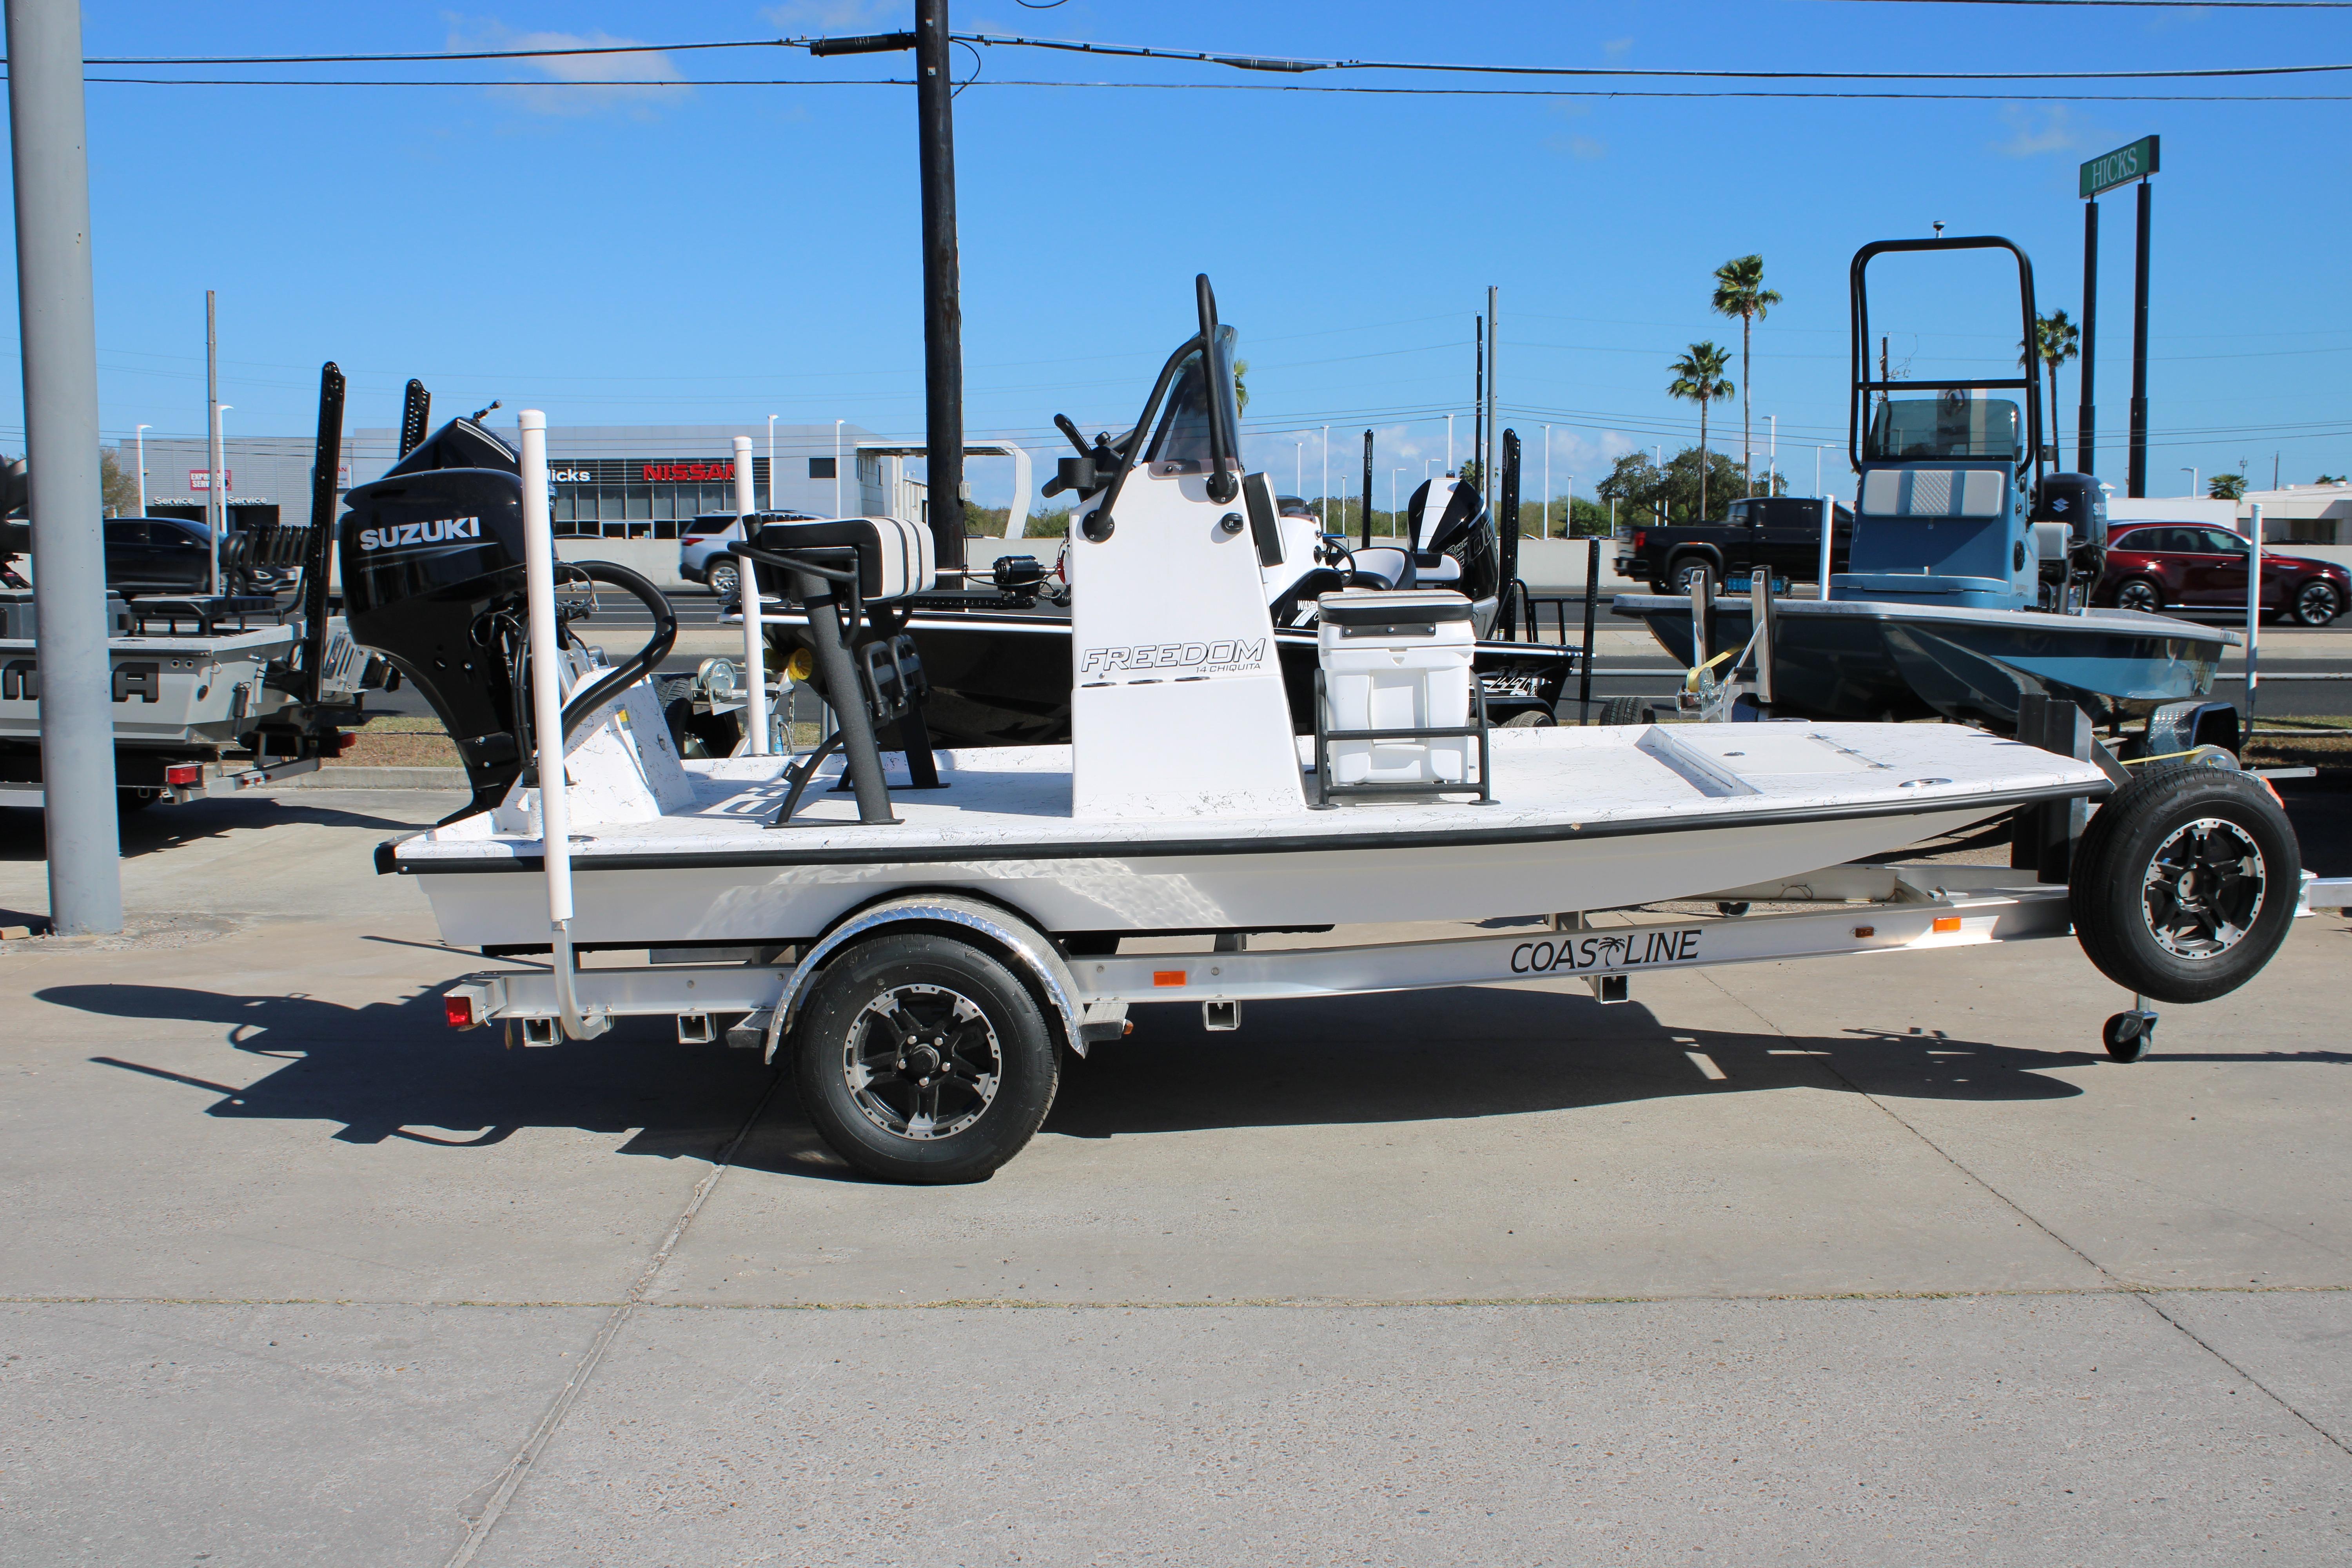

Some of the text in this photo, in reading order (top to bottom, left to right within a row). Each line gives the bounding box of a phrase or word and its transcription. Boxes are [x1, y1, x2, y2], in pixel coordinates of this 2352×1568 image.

[2092, 147, 2138, 189] HICKS
[547, 468, 590, 482] icks
[154, 496, 195, 505] Service
[227, 495, 268, 504] Service
[359, 516, 480, 550] SUZUKI
[1081, 638, 1266, 672] FREEDOM
[1209, 662, 1261, 672] CHIQUITA
